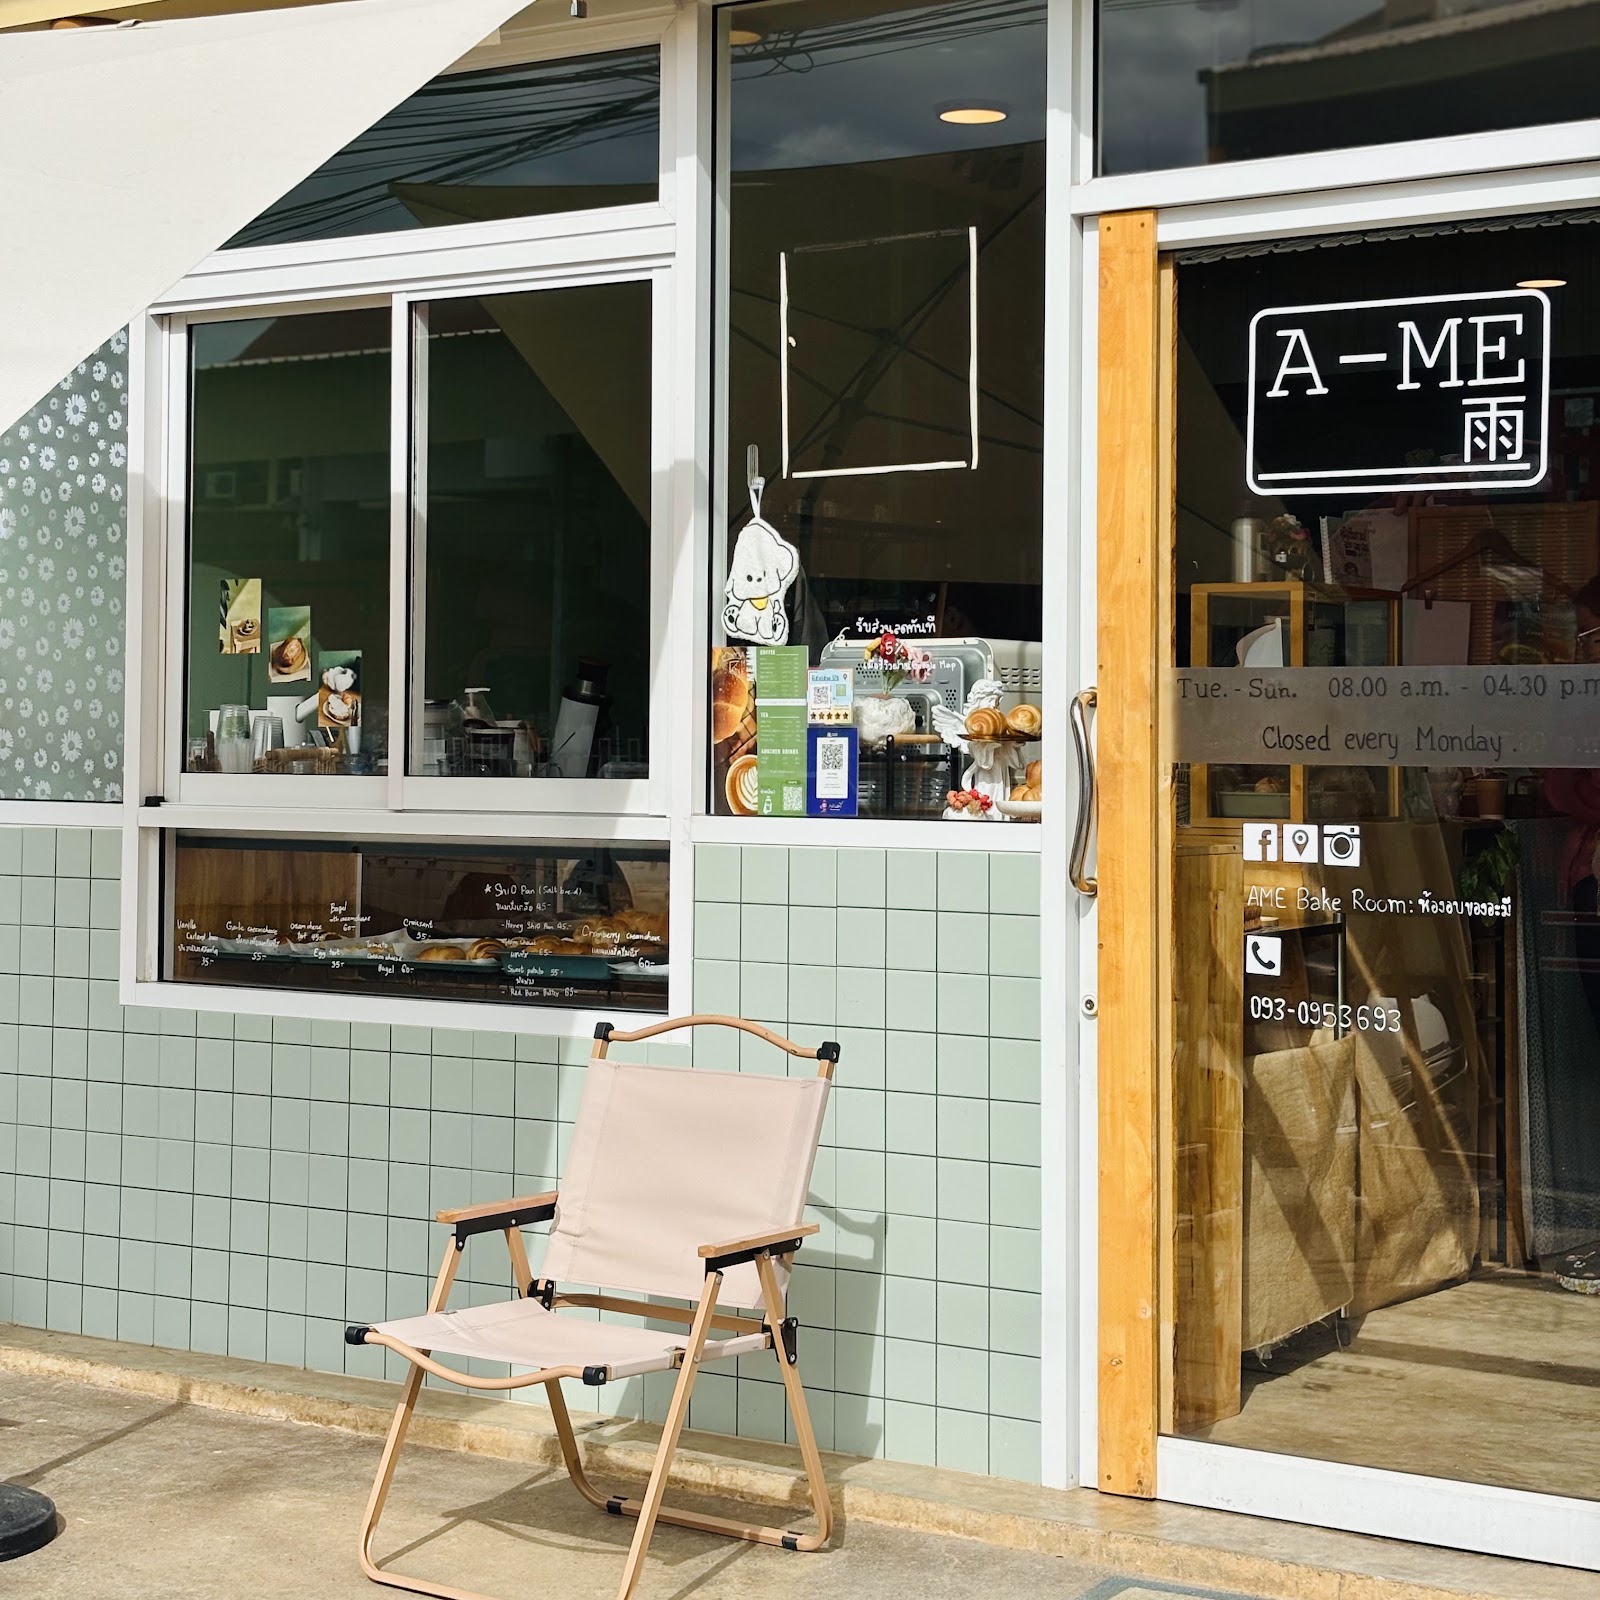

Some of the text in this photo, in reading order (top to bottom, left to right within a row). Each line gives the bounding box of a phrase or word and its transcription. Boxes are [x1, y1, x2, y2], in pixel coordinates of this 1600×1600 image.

[1462, 395, 1526, 463] 雨
[885, 641, 904, 655] 5%
[939, 660, 957, 672] Map
[1328, 676, 1389, 698] 08.00
[1399, 681, 1450, 698] a.m.
[1483, 674, 1548, 697] 04.30
[1262, 724, 1332, 752] Closed
[1344, 732, 1399, 761] every
[520, 884, 535, 895] Pan
[1247, 886, 1512, 918] AME Bake Room: ห้องอบของอะมี
[582, 925, 621, 944] Cranberry
[313, 948, 326, 960] Egg
[1250, 995, 1401, 1033] 093-0953693
